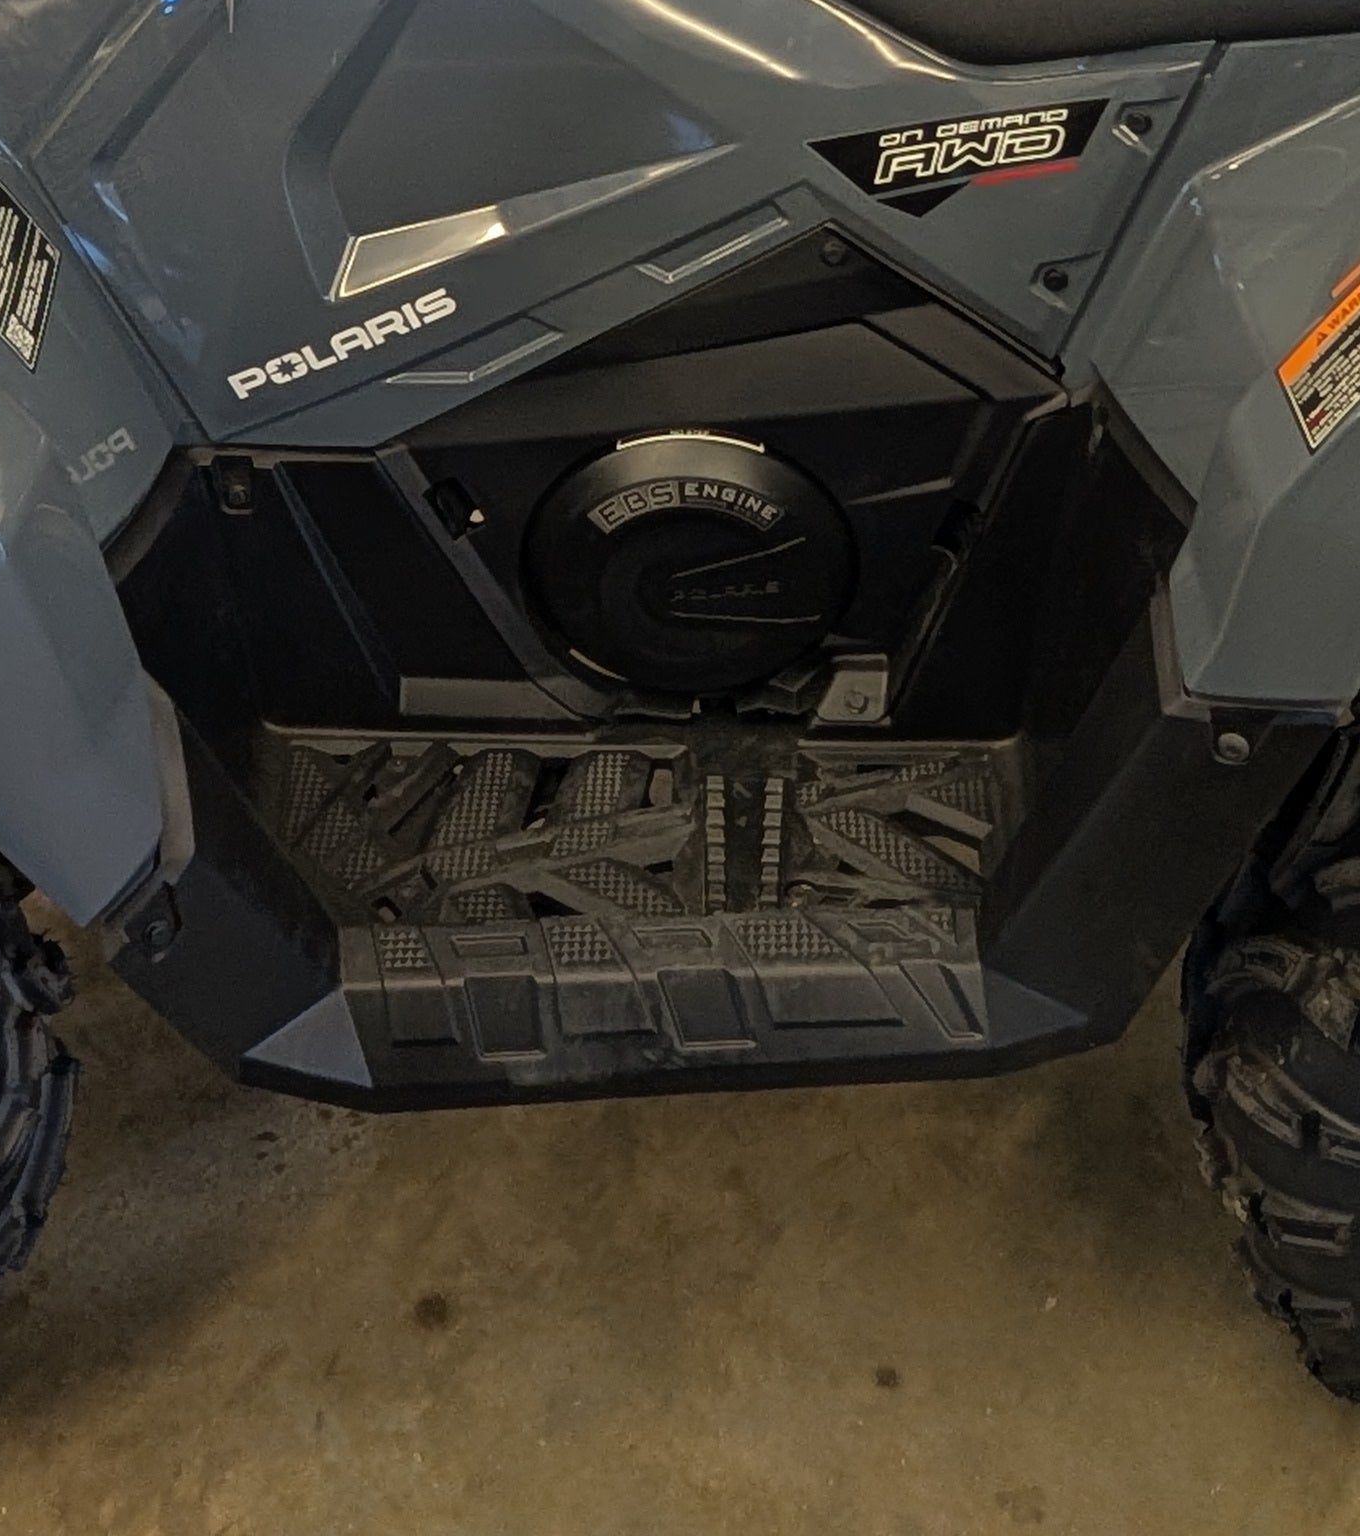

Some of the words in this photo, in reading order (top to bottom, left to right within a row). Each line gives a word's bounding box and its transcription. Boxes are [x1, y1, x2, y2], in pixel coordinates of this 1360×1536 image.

[878, 128, 924, 148] ON
[936, 108, 1069, 137] DEMAND
[873, 124, 1066, 185] AWD
[227, 287, 457, 400] POLARIS
[597, 483, 674, 526] EBS
[684, 482, 778, 522] ENGINE
